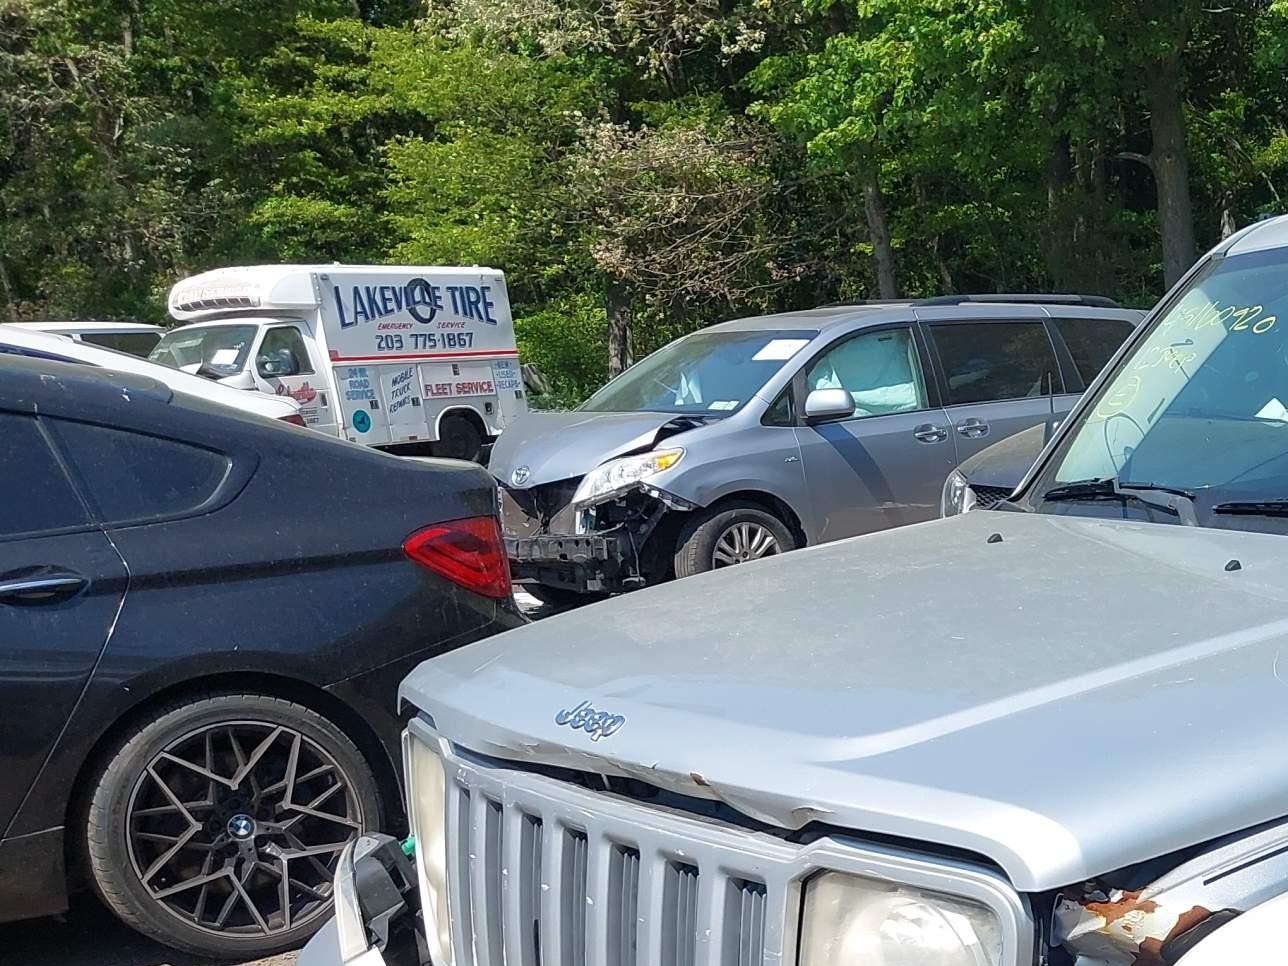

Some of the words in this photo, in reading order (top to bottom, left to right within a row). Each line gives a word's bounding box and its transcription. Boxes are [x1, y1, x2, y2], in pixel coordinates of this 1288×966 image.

[333, 285, 444, 330] LAKEVILLE
[446, 285, 498, 326] TIRE
[377, 322, 414, 331] EMERGENCY
[437, 321, 466, 329] SERVICE
[375, 334, 403, 351] 203
[391, 367, 414, 387] MOBILE
[391, 382, 411, 400] TRUCK
[424, 382, 453, 397] FLEET
[455, 380, 494, 395] SERVICE
[555, 700, 626, 742] Jeep
